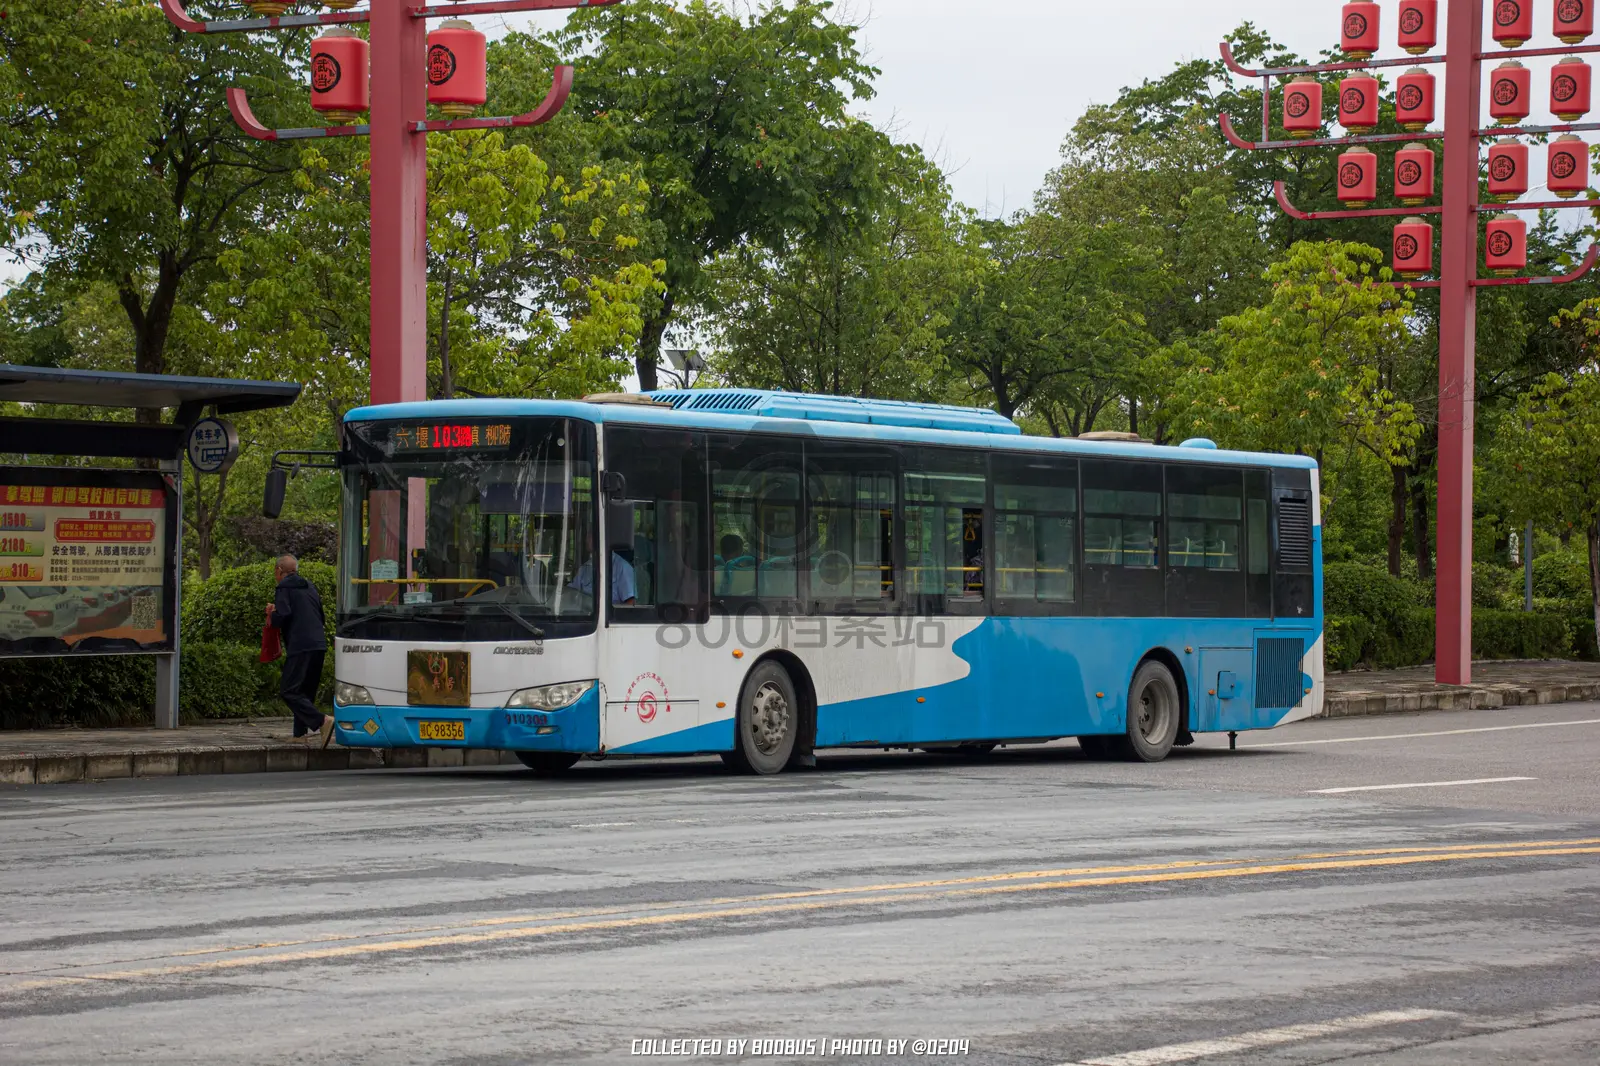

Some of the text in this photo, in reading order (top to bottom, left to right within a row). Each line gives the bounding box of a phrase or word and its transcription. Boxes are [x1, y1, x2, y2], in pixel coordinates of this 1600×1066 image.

[195, 428, 222, 440] 候车亭
[360, 645, 383, 653] LONG
